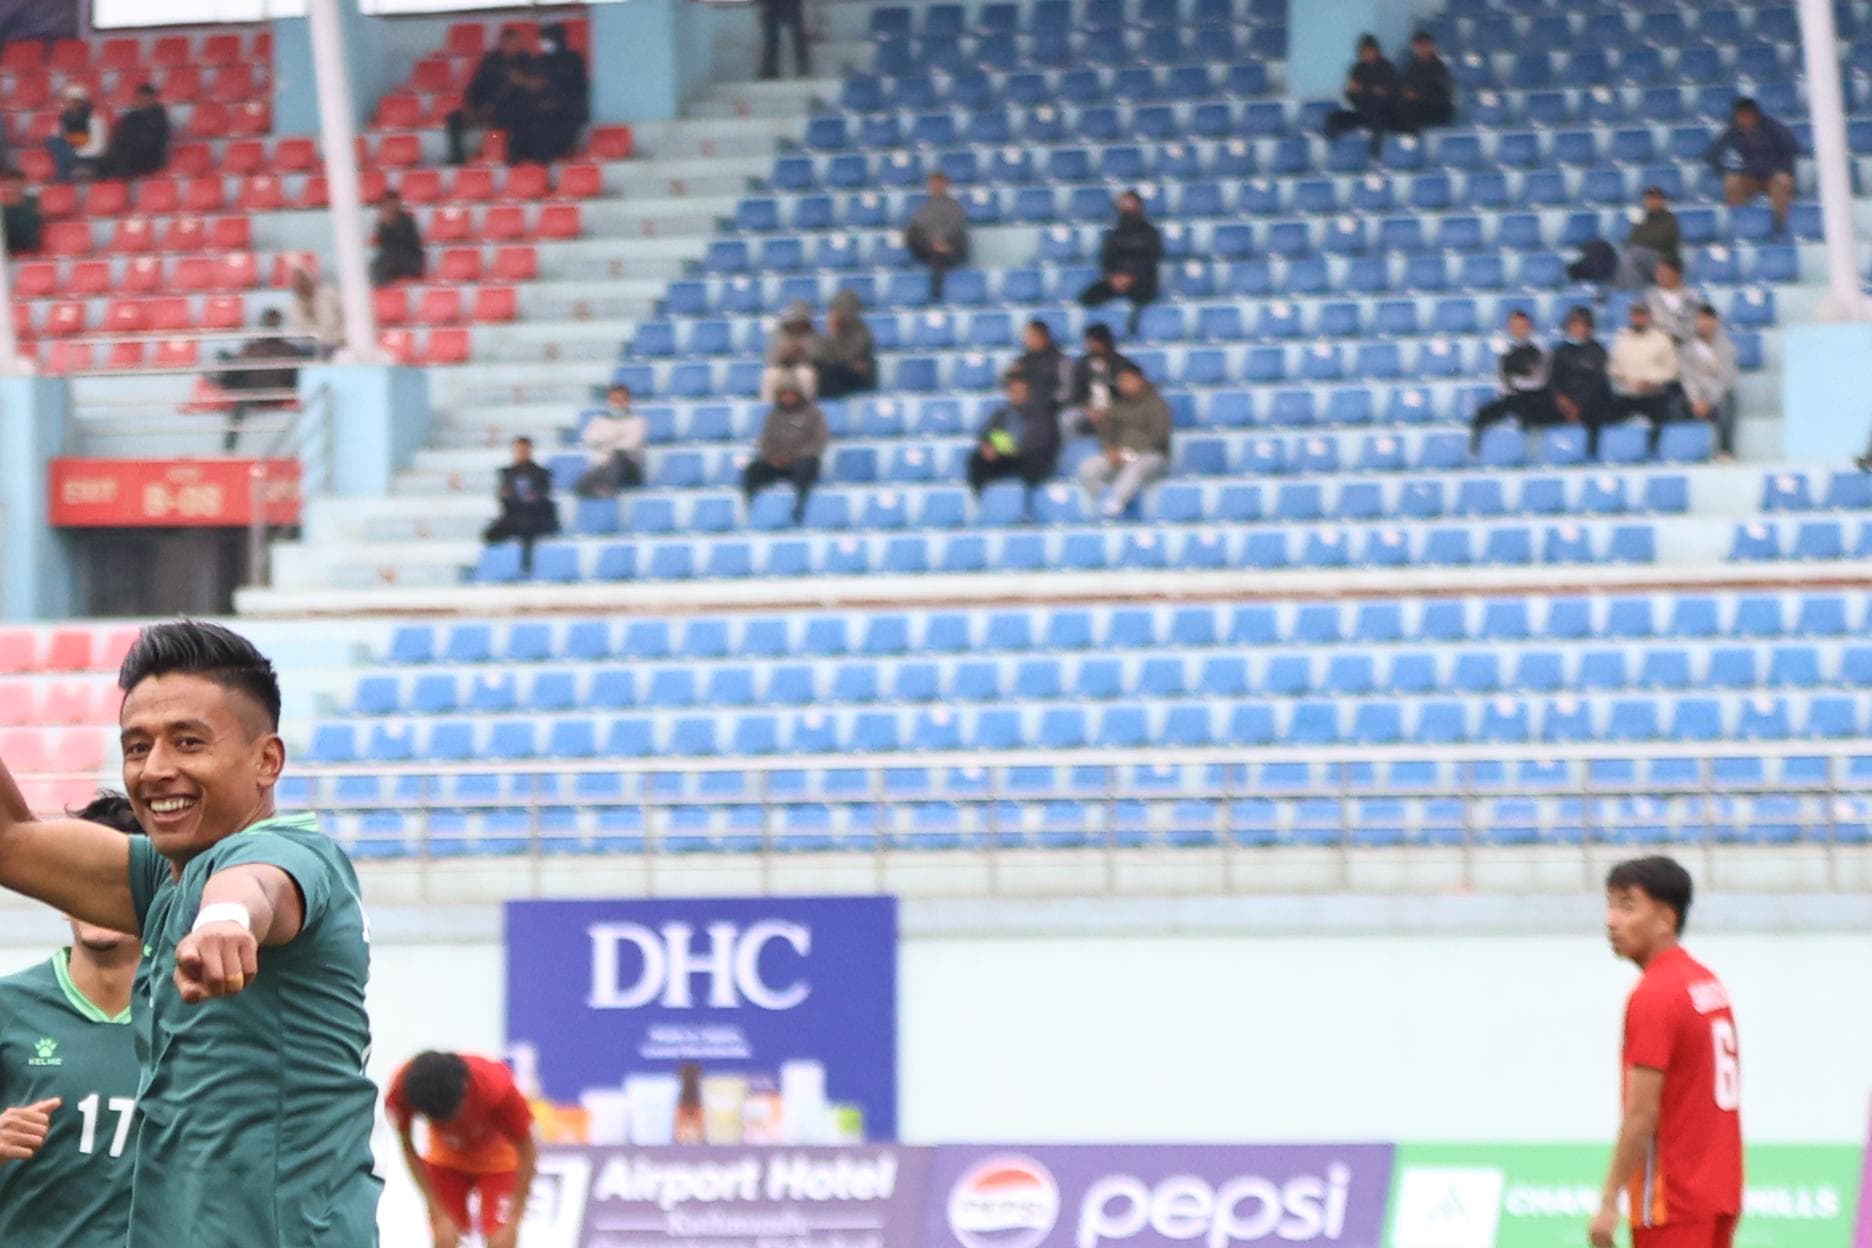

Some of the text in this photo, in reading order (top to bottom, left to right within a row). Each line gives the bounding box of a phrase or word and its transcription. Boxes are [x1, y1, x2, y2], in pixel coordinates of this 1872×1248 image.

[587, 919, 812, 1010] DHC
[28, 1058, 62, 1066] KELME
[1711, 1017, 1741, 1112] 6
[77, 1093, 136, 1158] 17
[594, 1152, 898, 1212] Airport Hotel
